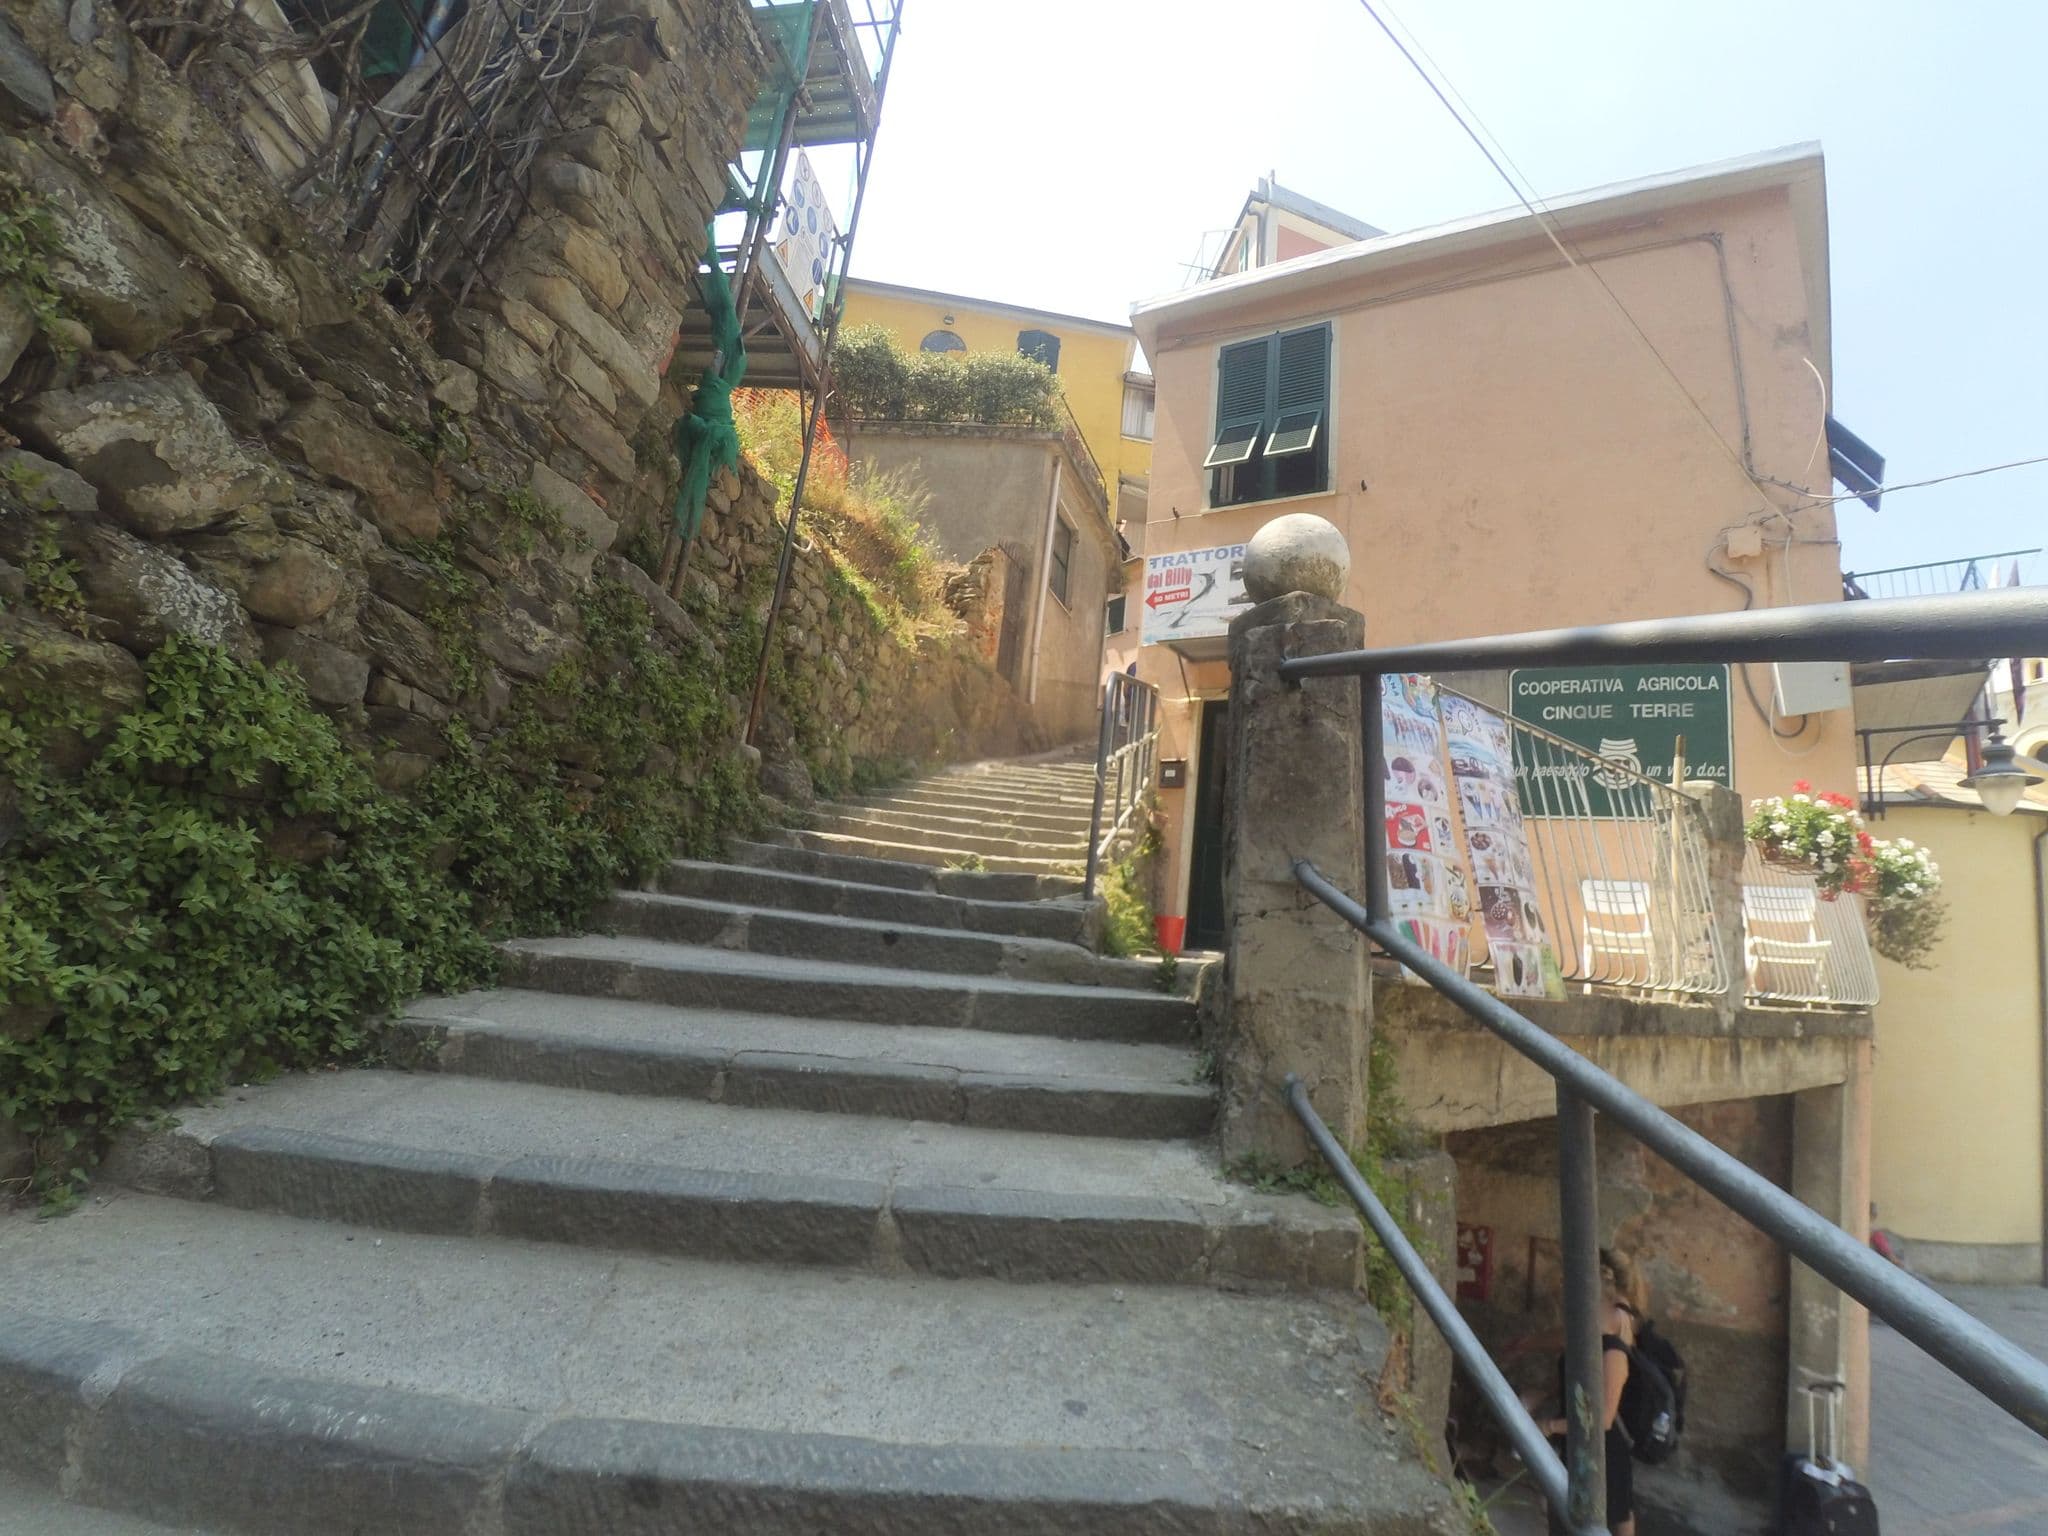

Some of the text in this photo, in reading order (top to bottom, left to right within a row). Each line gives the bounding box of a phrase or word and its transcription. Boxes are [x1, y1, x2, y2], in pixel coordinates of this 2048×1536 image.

[1149, 545, 1248, 569] TRATTOR
[1147, 567, 1192, 589] dal Billy
[1518, 675, 1720, 696] COOPERATIVA AGRICOLA
[1542, 703, 1694, 721] CINQUE TERRE
[1646, 765, 1662, 777] un
[1667, 765, 1692, 777] vo
[1696, 762, 1726, 777] d.o.c.
